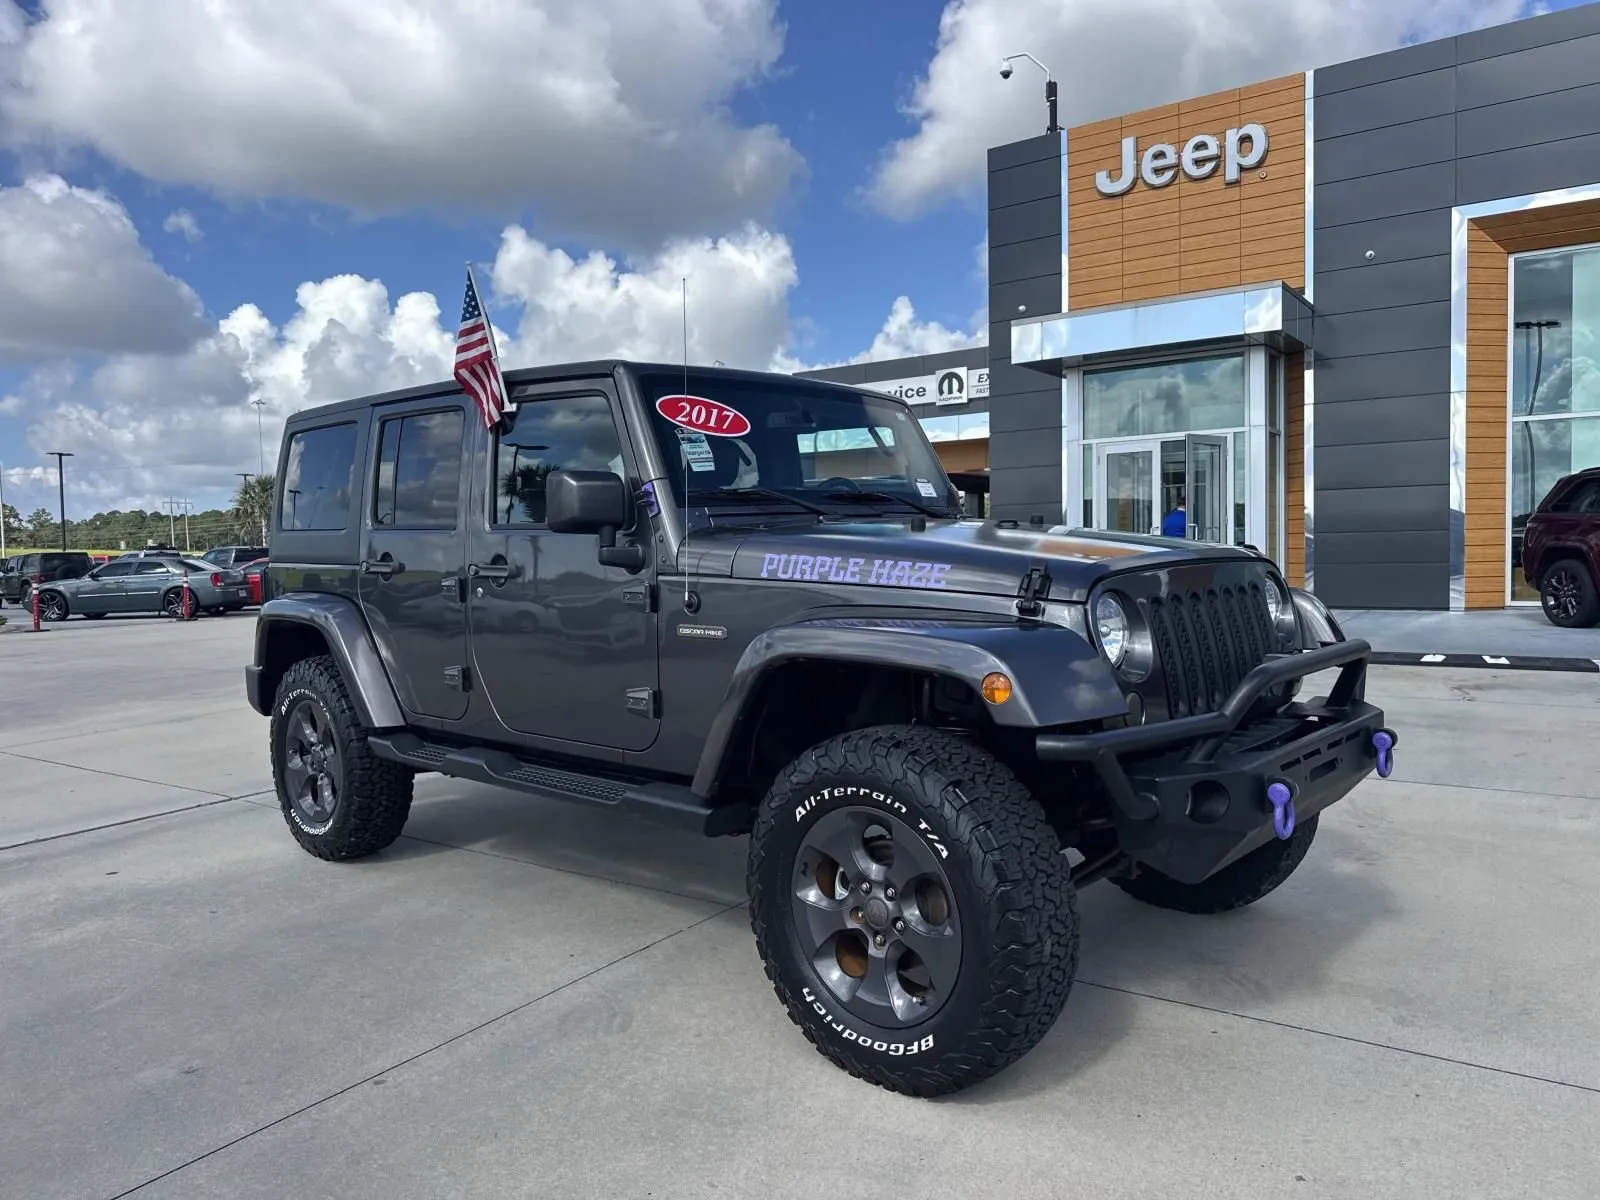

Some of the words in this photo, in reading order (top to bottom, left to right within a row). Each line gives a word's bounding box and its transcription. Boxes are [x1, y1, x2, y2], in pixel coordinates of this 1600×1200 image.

[1095, 122, 1269, 197] Jeep
[675, 401, 736, 430] 2017
[888, 385, 927, 398] vice
[760, 553, 866, 583] PURPLE
[868, 559, 952, 588] HAZE
[795, 786, 908, 823] All-Terrain
[917, 818, 949, 860] T/A
[801, 986, 935, 1056] BFGoodrich
